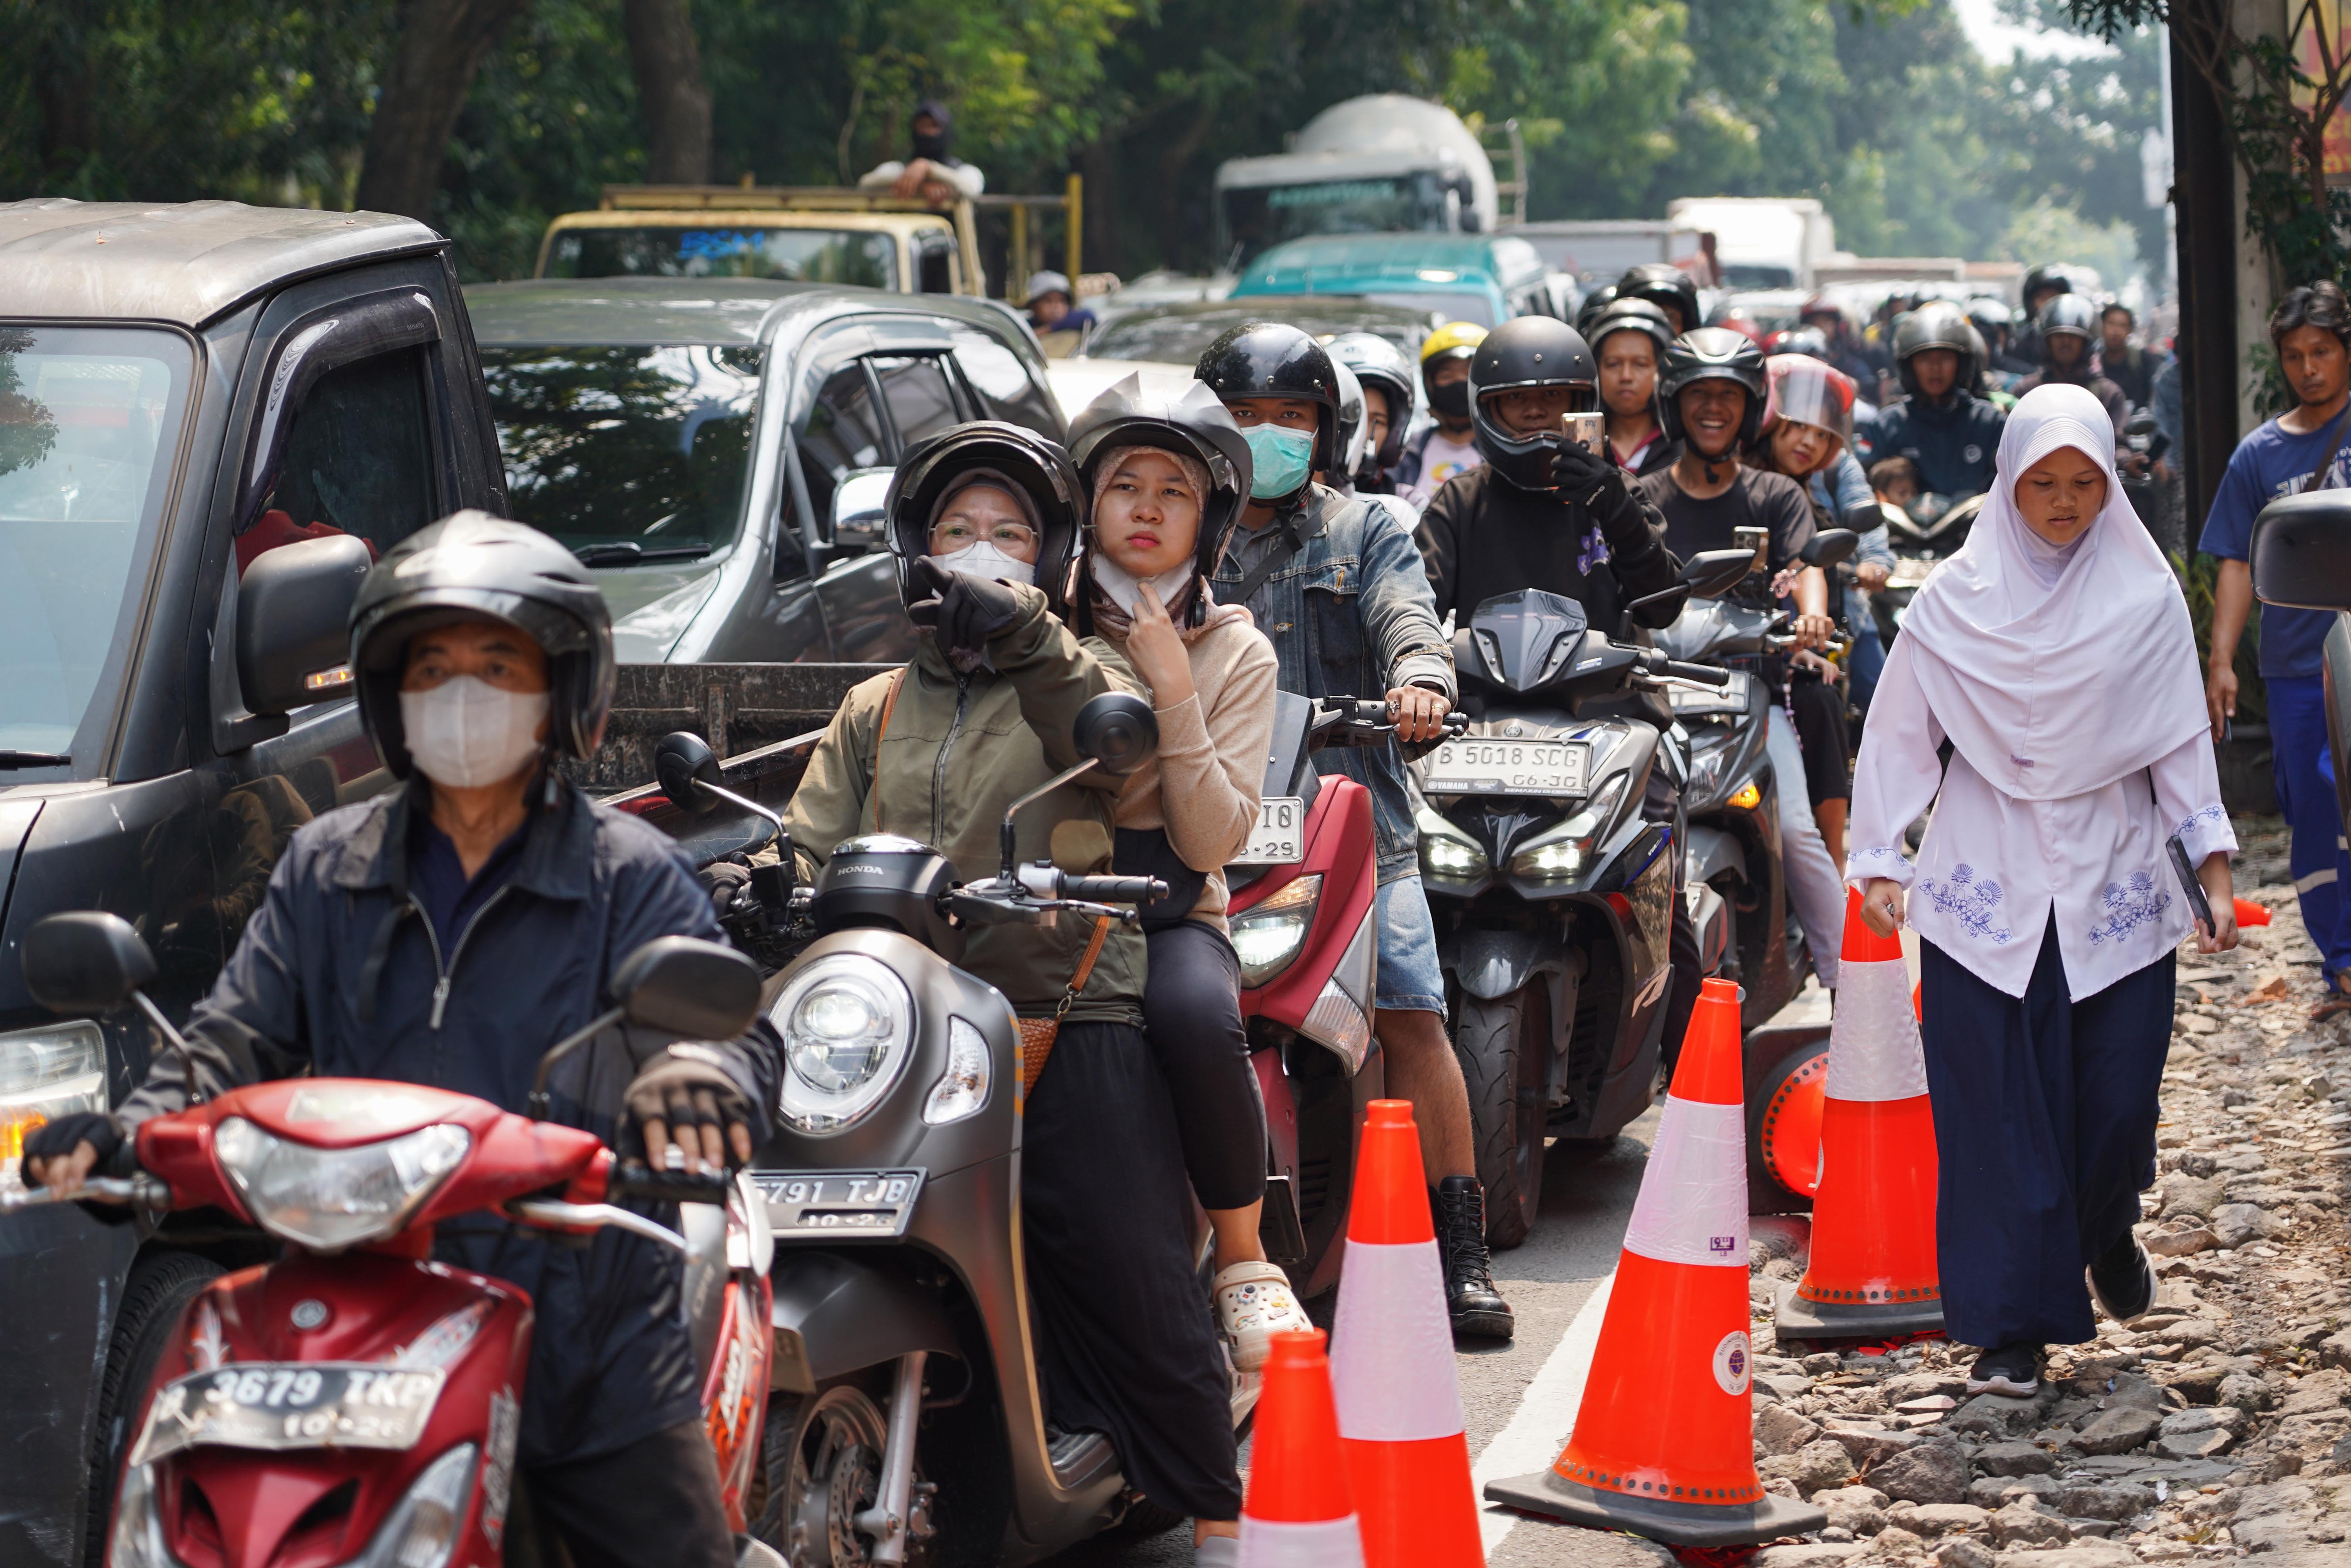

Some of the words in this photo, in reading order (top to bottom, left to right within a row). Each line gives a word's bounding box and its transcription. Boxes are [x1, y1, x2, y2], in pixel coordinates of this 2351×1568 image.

[1440, 746, 1453, 764] B
[1466, 746, 1523, 765] 5018
[1437, 781, 1469, 790] YAMAHA
[837, 866, 884, 876] HONDA
[846, 1179, 907, 1203] TJB
[203, 1371, 323, 1407] 3679
[343, 1371, 437, 1407] TKP
